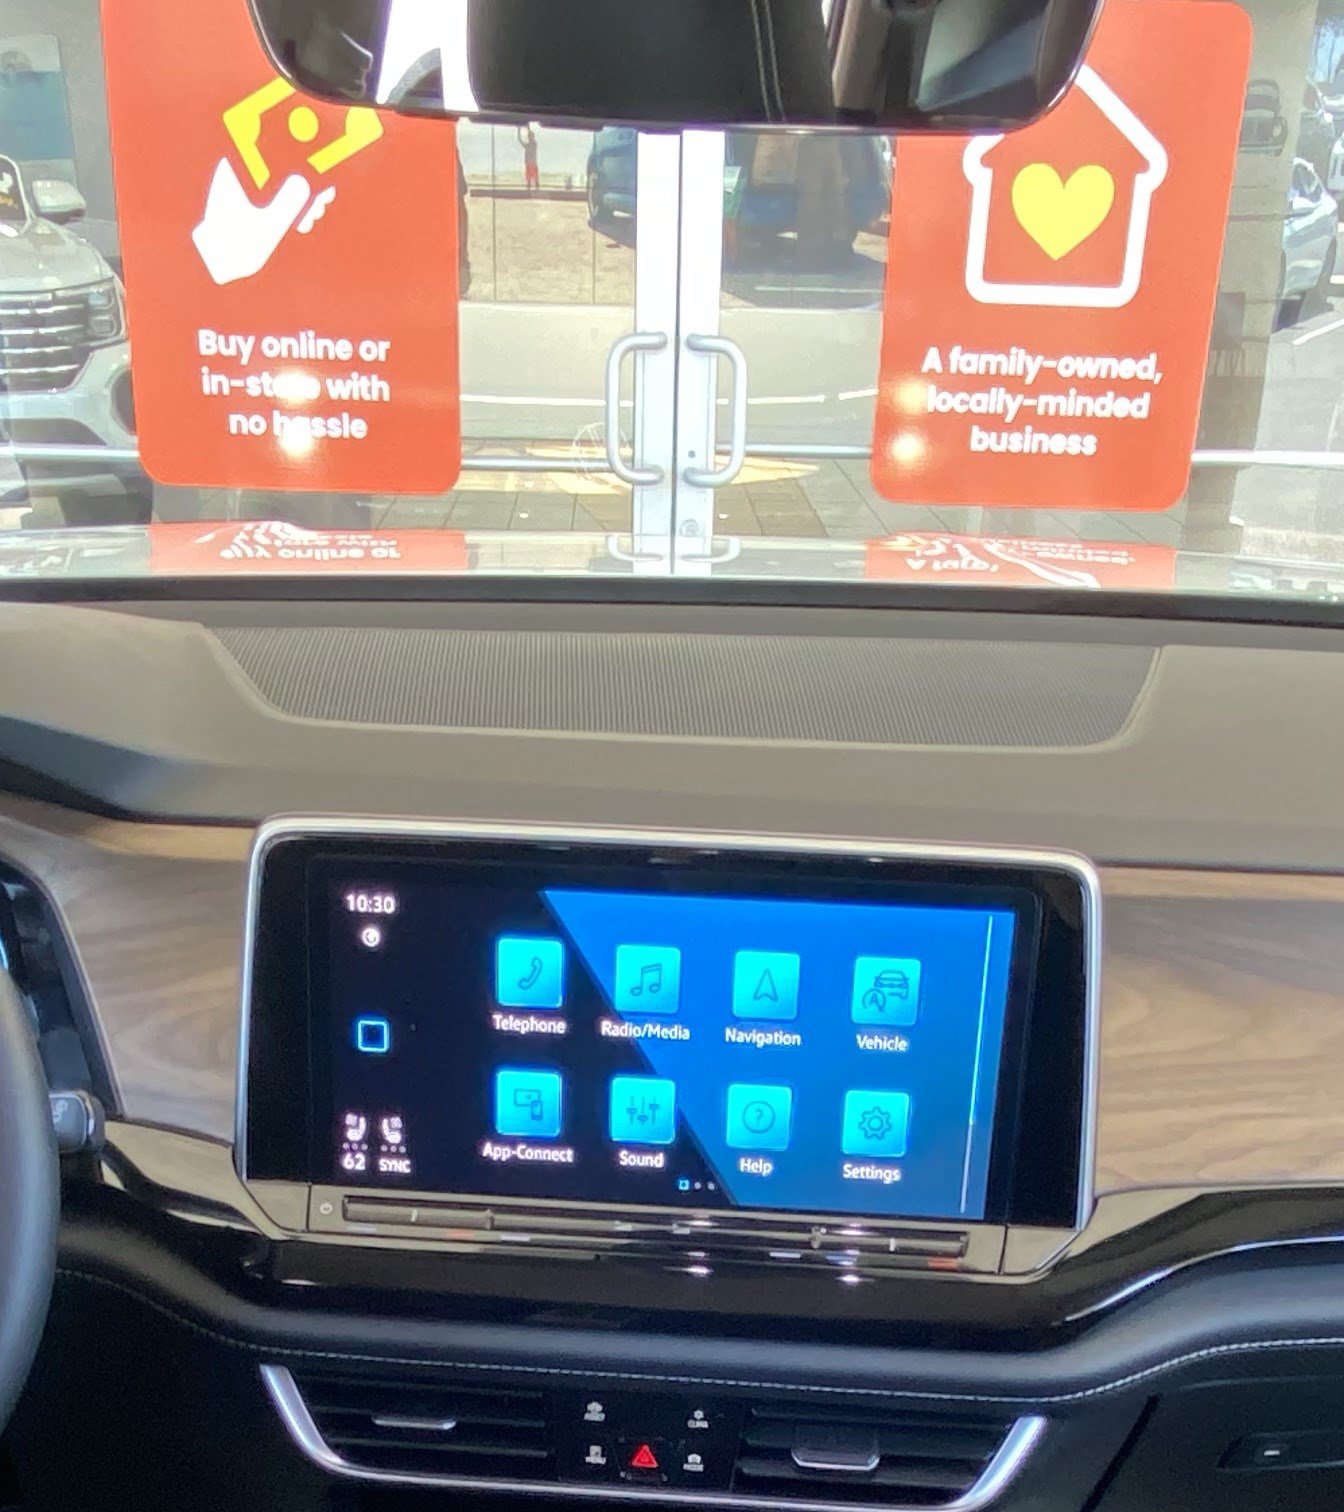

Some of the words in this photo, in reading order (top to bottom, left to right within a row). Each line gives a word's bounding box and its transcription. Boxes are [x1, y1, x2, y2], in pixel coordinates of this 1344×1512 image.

[198, 328, 256, 365] Buy
[261, 329, 354, 361] online
[359, 339, 391, 361] or
[920, 346, 943, 374] A
[949, 345, 1163, 386] family-owned,
[201, 365, 321, 400] in-st
[326, 371, 390, 402] with
[926, 384, 1151, 424] locally-minded
[228, 413, 267, 435] no
[970, 424, 1098, 456] business
[346, 893, 396, 915] 10:30
[492, 1014, 567, 1036] Telephone
[600, 1020, 691, 1042] Radio/Media
[724, 1027, 803, 1049] Navigation
[855, 1034, 909, 1052] Vehicle
[342, 1153, 367, 1172] 62
[482, 1142, 575, 1163] App-Connect
[618, 1150, 665, 1169] Sound
[379, 1157, 412, 1174] SYNC
[739, 1157, 774, 1177] Help
[842, 1162, 902, 1185] Settings
